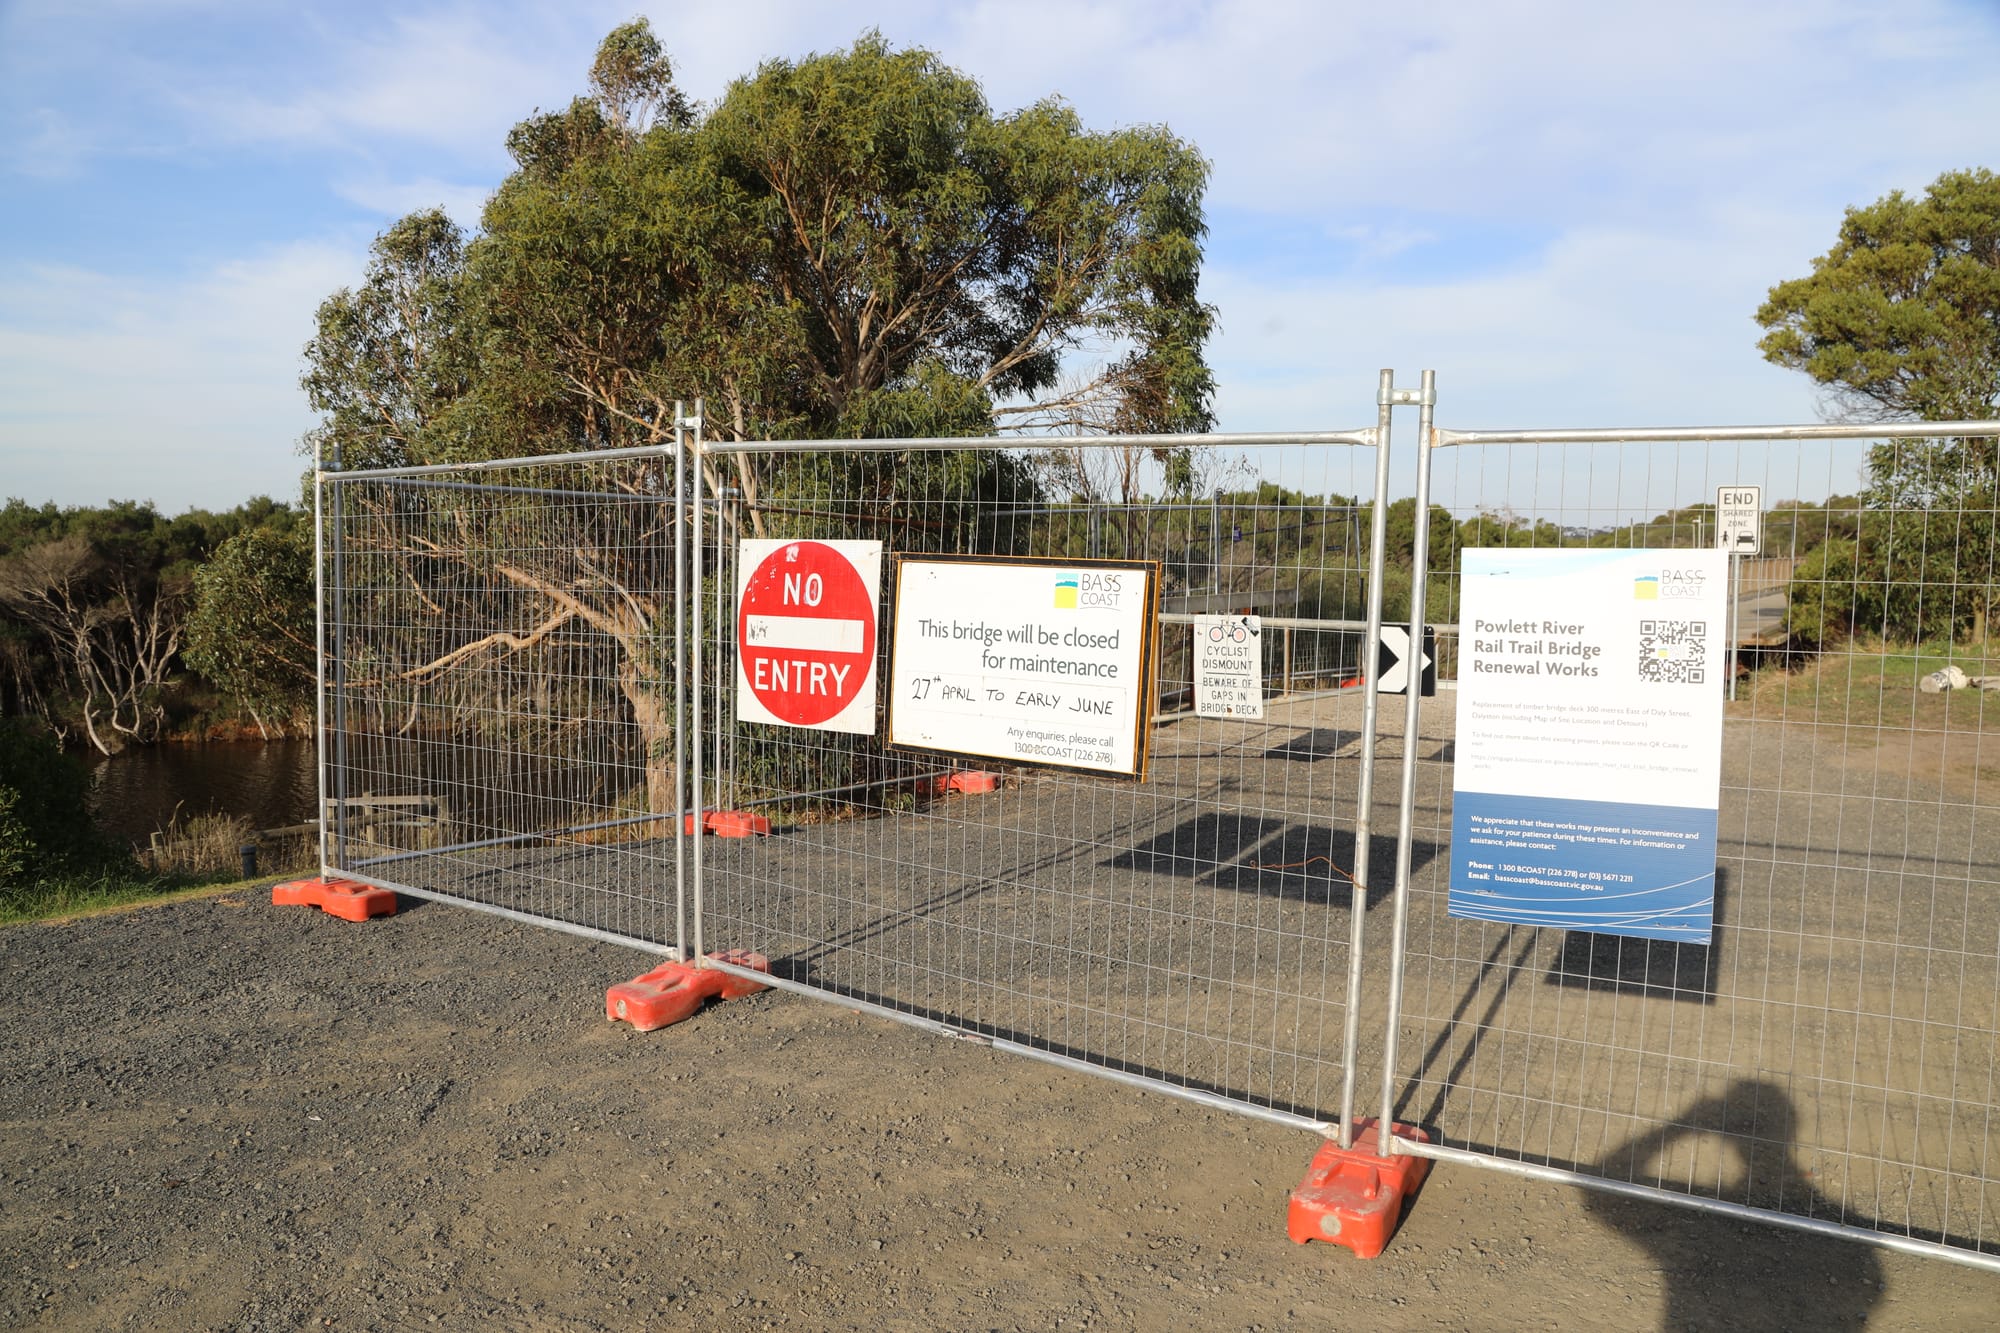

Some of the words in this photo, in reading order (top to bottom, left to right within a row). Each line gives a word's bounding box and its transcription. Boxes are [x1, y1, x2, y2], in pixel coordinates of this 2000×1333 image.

[1724, 493, 1753, 504] END
[1081, 573, 1122, 592] BASS
[1662, 570, 1703, 585] BASS
[783, 573, 823, 607] NO
[1662, 585, 1702, 596] COAST
[1080, 592, 1121, 607] COAST
[919, 619, 948, 638] This
[953, 621, 1002, 647] bridge
[1007, 624, 1033, 644] will
[1038, 625, 1059, 645] be
[1063, 627, 1120, 650] closed
[1475, 619, 1537, 634] Powlett
[1543, 621, 1584, 635] River
[1207, 646, 1248, 657] CYCLIST
[1474, 640, 1503, 654] Rail
[1509, 641, 1543, 655] Trail
[1548, 642, 1601, 660] Bridge
[981, 649, 1006, 669] for
[1010, 654, 1118, 678] maintenance
[1202, 659, 1253, 670] DISMOUNT
[1474, 660, 1540, 675] Renewal
[1547, 662, 1599, 677] Works
[754, 657, 851, 697] ENTRY
[1203, 677, 1237, 687] BEWARE
[1242, 679, 1252, 688] OF
[942, 684, 976, 702] APRIL
[986, 689, 1004, 701] TO
[1016, 691, 1060, 709] EARLY
[1069, 697, 1114, 715] JUNE
[1211, 691, 1233, 701] GAPS
[1237, 692, 1246, 701] IN
[1201, 704, 1231, 713] BRIDGE
[1236, 705, 1257, 715] DECK
[1547, 704, 1567, 712] bridge
[1651, 709, 1666, 717] Daly
[1534, 715, 1547, 723] Map
[1617, 719, 1648, 728] Detours)
[1007, 727, 1024, 739] Any
[1026, 730, 1067, 742] enquiries,
[1069, 733, 1097, 745] please
[1099, 737, 1114, 747] call
[1075, 750, 1093, 761] (226
[1484, 817, 1518, 825] appreciate
[1536, 820, 1554, 828] these
[1556, 822, 1576, 830] works
[1578, 824, 1592, 833] may
[1632, 828, 1683, 838] inconvenience
[1470, 837, 1505, 846] assistance,
[1506, 840, 1527, 848] please
[1522, 830, 1551, 839] patience
[1553, 833, 1575, 842] during
[1576, 834, 1596, 842] these
[1633, 839, 1675, 849] information
[1468, 872, 1490, 880] Email:
[1469, 861, 1494, 870] Phone:
[1517, 865, 1546, 874] BCOAST
[1548, 868, 1562, 876] (226
[1564, 870, 1578, 878] 278)
[1589, 872, 1601, 881] (03)
[1603, 873, 1618, 881] 5671
